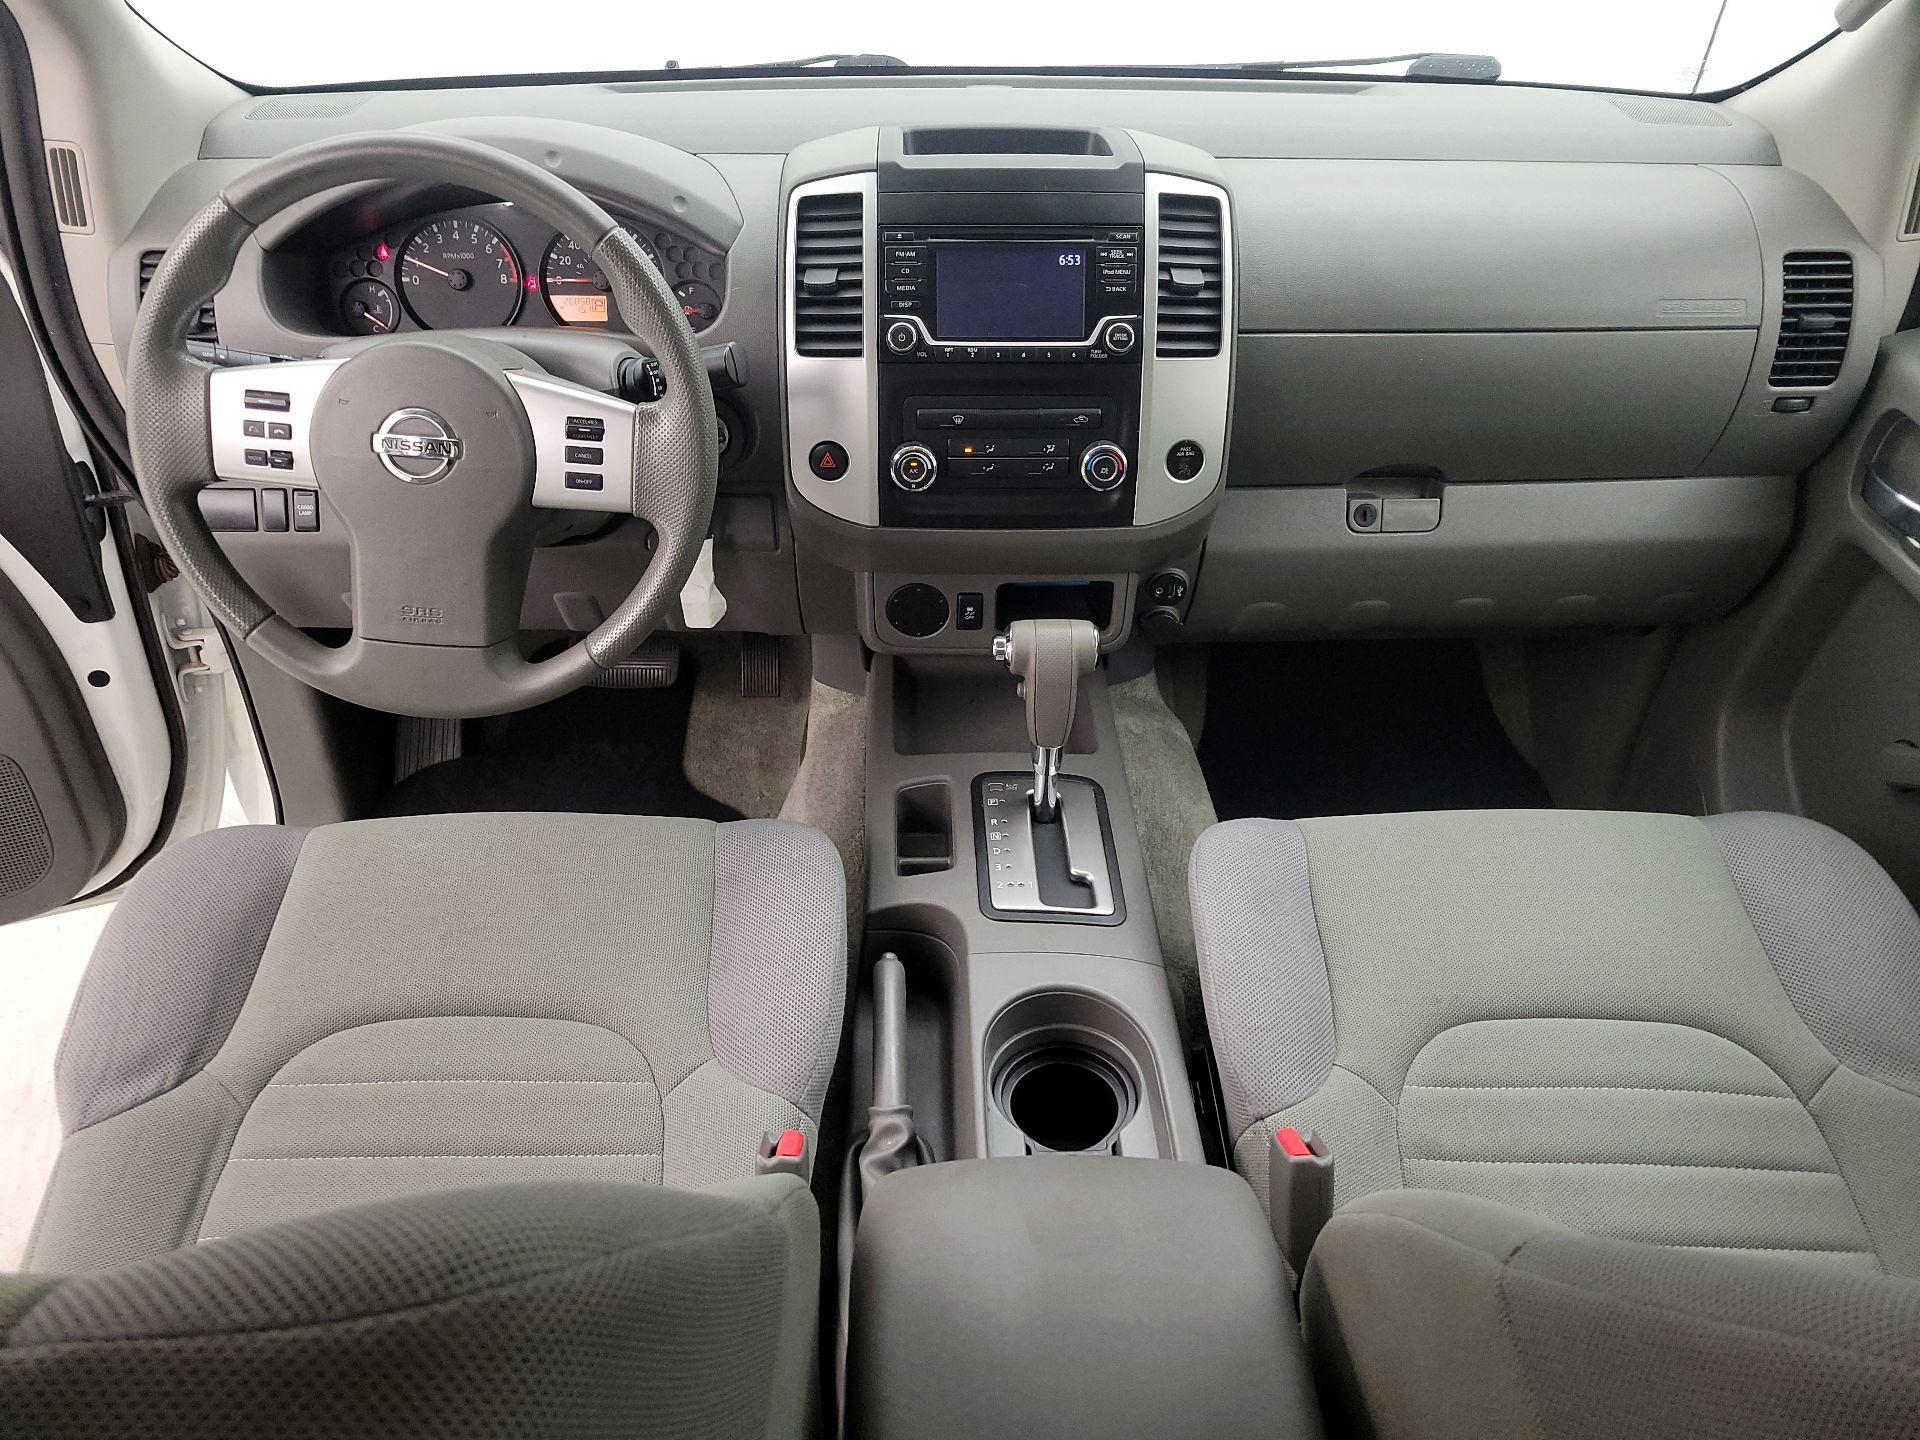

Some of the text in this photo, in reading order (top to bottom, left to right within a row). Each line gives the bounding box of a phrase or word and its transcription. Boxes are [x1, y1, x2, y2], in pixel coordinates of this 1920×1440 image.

[436, 233, 443, 244] 3
[452, 230, 460, 241] 4
[471, 234, 478, 244] 5
[423, 243, 430, 254] 2
[485, 244, 493, 254] 6
[495, 258, 503, 269] 7
[558, 256, 572, 266] 20
[1058, 254, 1081, 266] 6:53
[412, 275, 420, 286] 0
[500, 273, 508, 284] 8
[369, 284, 376, 293] H
[688, 287, 695, 295] F
[381, 438, 452, 455] NISSAN
[400, 605, 443, 617] SRS
[991, 818, 998, 826] R
[993, 847, 1001, 855] D
[995, 863, 1002, 871] 3
[996, 880, 1003, 889] 2
